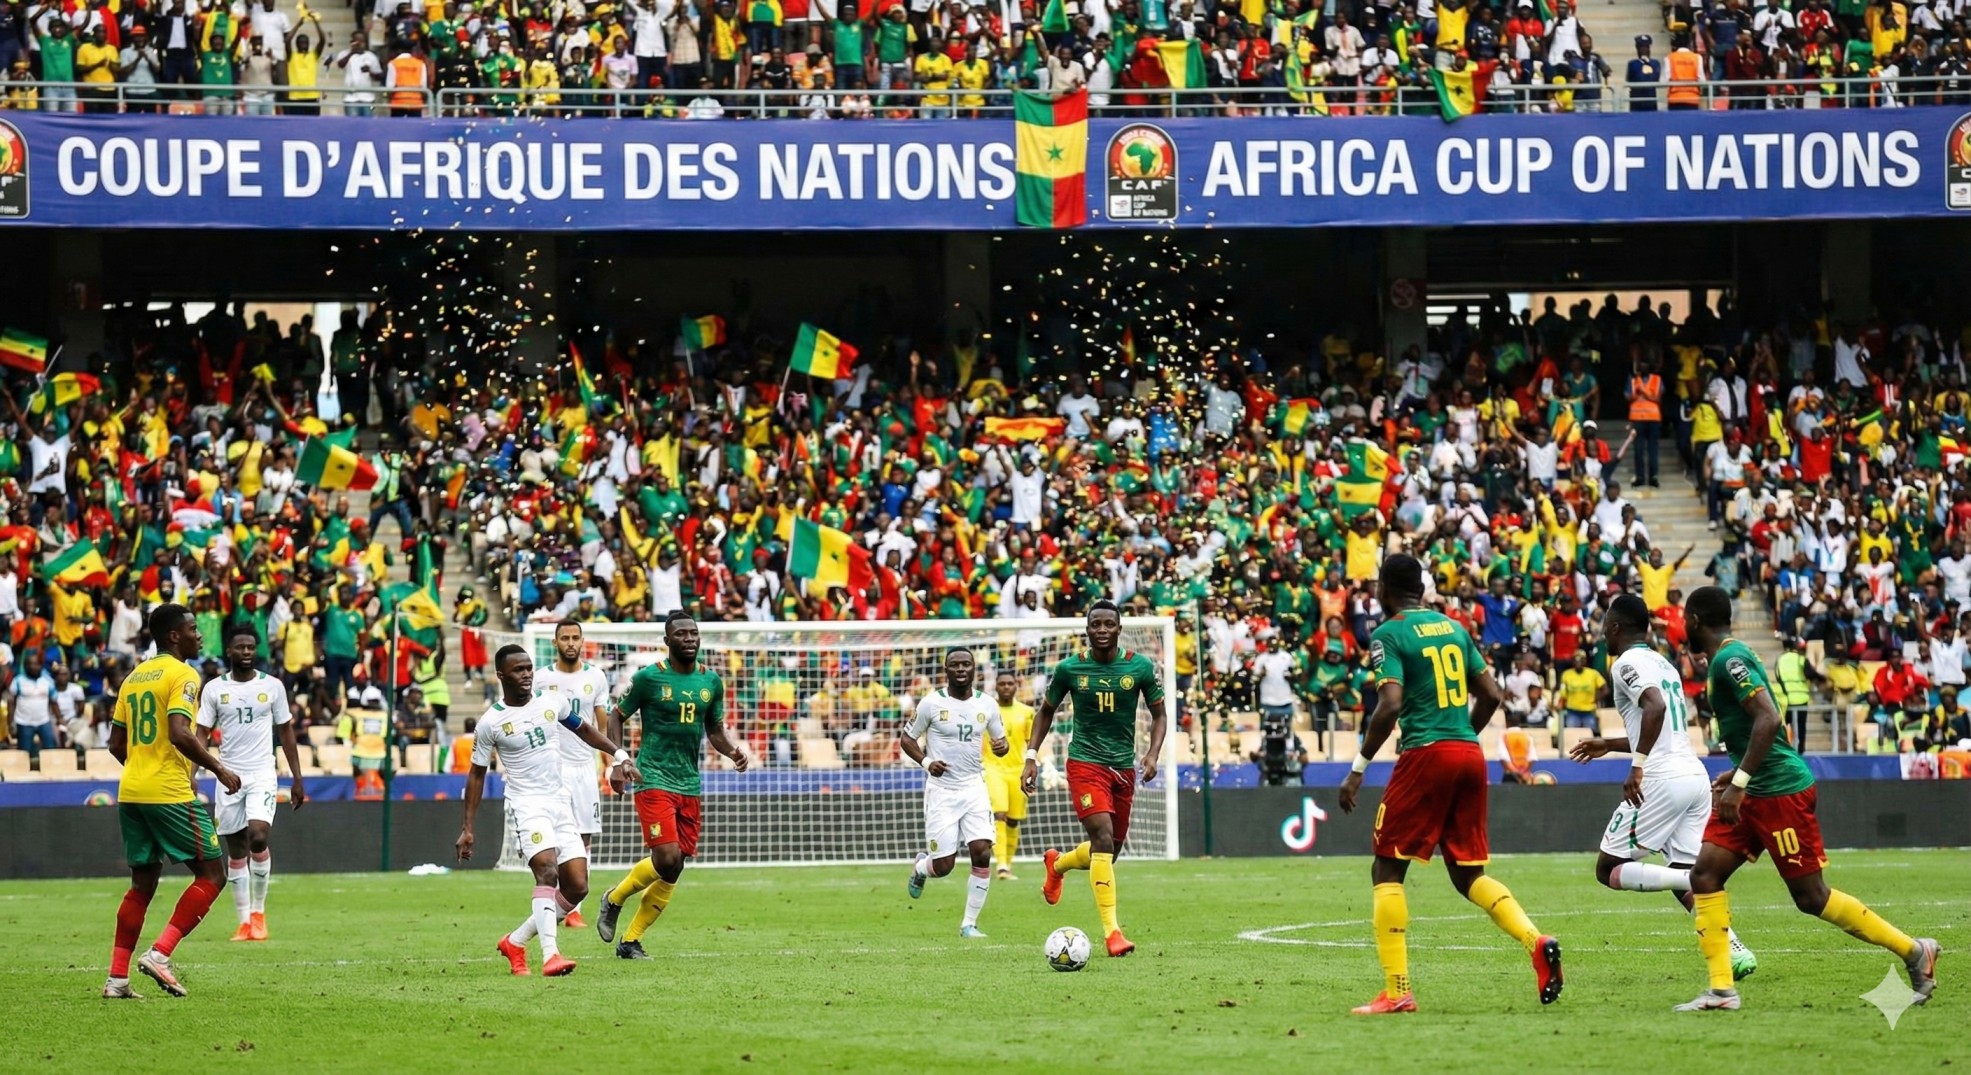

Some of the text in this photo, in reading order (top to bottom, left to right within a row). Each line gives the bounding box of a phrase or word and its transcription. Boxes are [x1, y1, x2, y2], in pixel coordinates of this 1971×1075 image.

[57, 136, 1016, 205] COUPE D'AFRIQUE DES NATIONS
[1202, 130, 1921, 197] AFRICA CUP OF NATIONS
[1121, 180, 1162, 190] CAF
[1422, 643, 1468, 709] 19
[679, 702, 696, 723] 13
[1095, 691, 1115, 713] 14
[127, 690, 158, 747] 18
[236, 706, 254, 724] 13
[524, 726, 547, 750] 19
[956, 723, 974, 742] 12
[1772, 827, 1801, 857] 10
